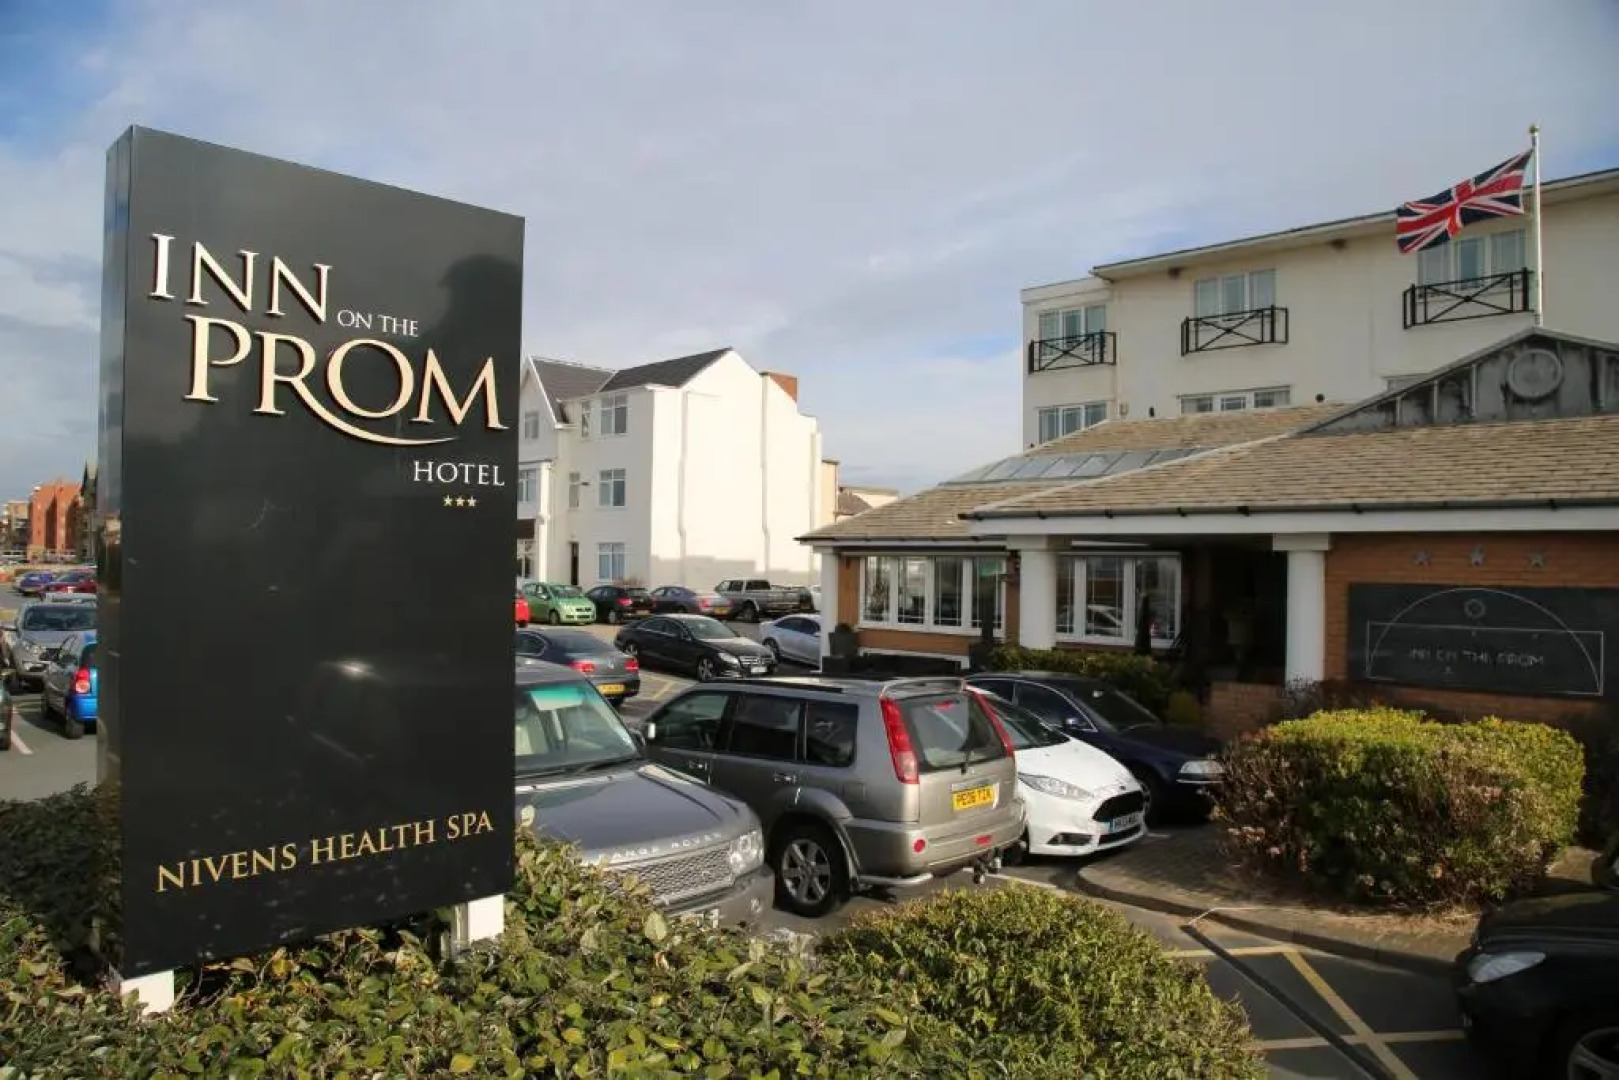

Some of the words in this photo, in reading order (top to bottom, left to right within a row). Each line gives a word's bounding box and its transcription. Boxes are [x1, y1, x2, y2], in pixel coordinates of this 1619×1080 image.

[149, 233, 333, 323] INN
[337, 309, 373, 330] ON
[377, 314, 419, 338] THE
[185, 314, 509, 446] PROM
[412, 460, 505, 486] HOTEL
[155, 843, 298, 893] NIVENS
[310, 820, 436, 866] HEALTH
[446, 810, 494, 839] SPA
